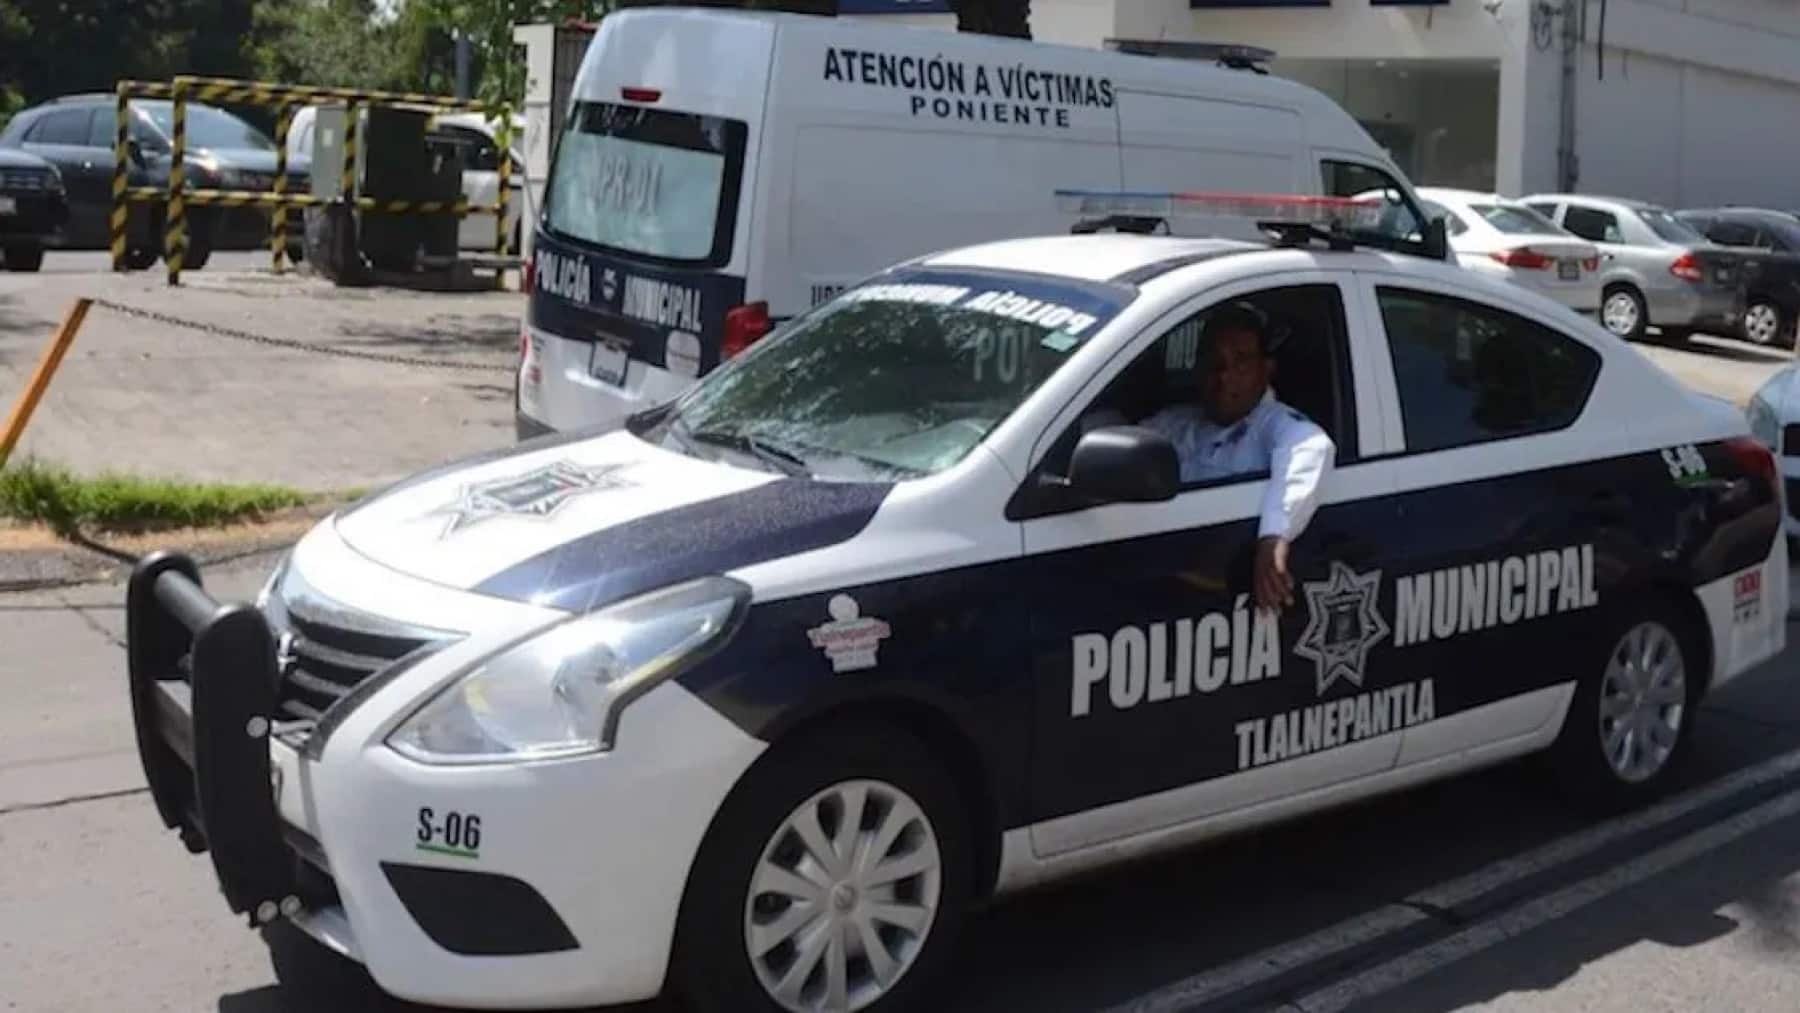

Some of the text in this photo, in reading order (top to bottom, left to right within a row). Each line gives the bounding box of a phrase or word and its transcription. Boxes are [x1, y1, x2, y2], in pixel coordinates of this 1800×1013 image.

[824, 47, 1114, 109] ATENCIÓN A VÍCTIMAS
[912, 96, 1070, 128] PONIENTE
[535, 250, 702, 333] POLICÍA MUNICIPAL
[1071, 543, 1599, 717] POLICÍA MUNICIPAL
[1235, 678, 1436, 770] TLALNEPANTLA
[417, 806, 481, 850] S-06
